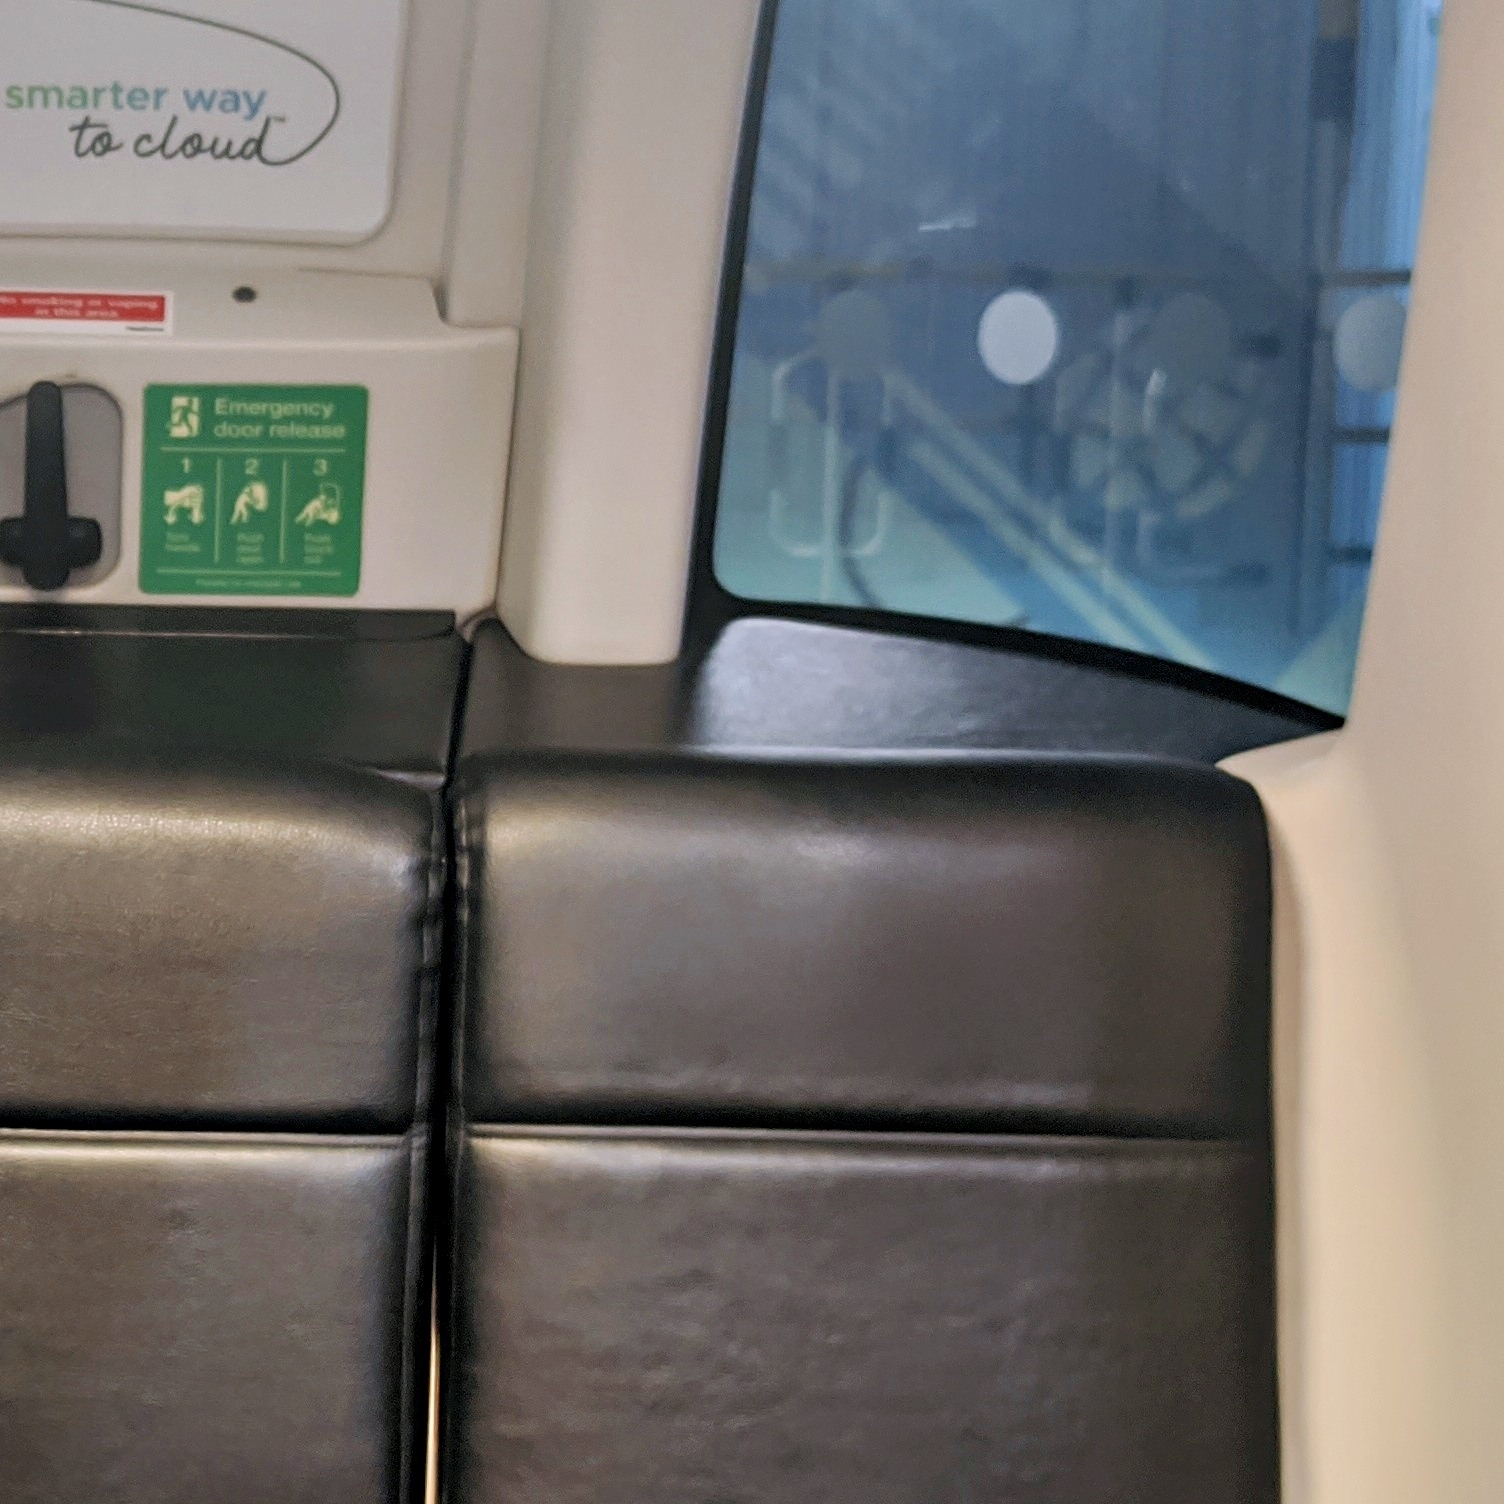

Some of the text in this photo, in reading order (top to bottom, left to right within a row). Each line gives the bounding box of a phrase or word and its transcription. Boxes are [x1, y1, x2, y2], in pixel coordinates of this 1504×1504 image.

[4, 81, 167, 111] smarter
[182, 88, 268, 121] way
[69, 114, 280, 165] to cloud
[214, 397, 336, 420] Emergency
[214, 421, 347, 439] door release
[181, 457, 191, 474] 1
[244, 458, 260, 476] 2
[313, 458, 329, 476] 3
